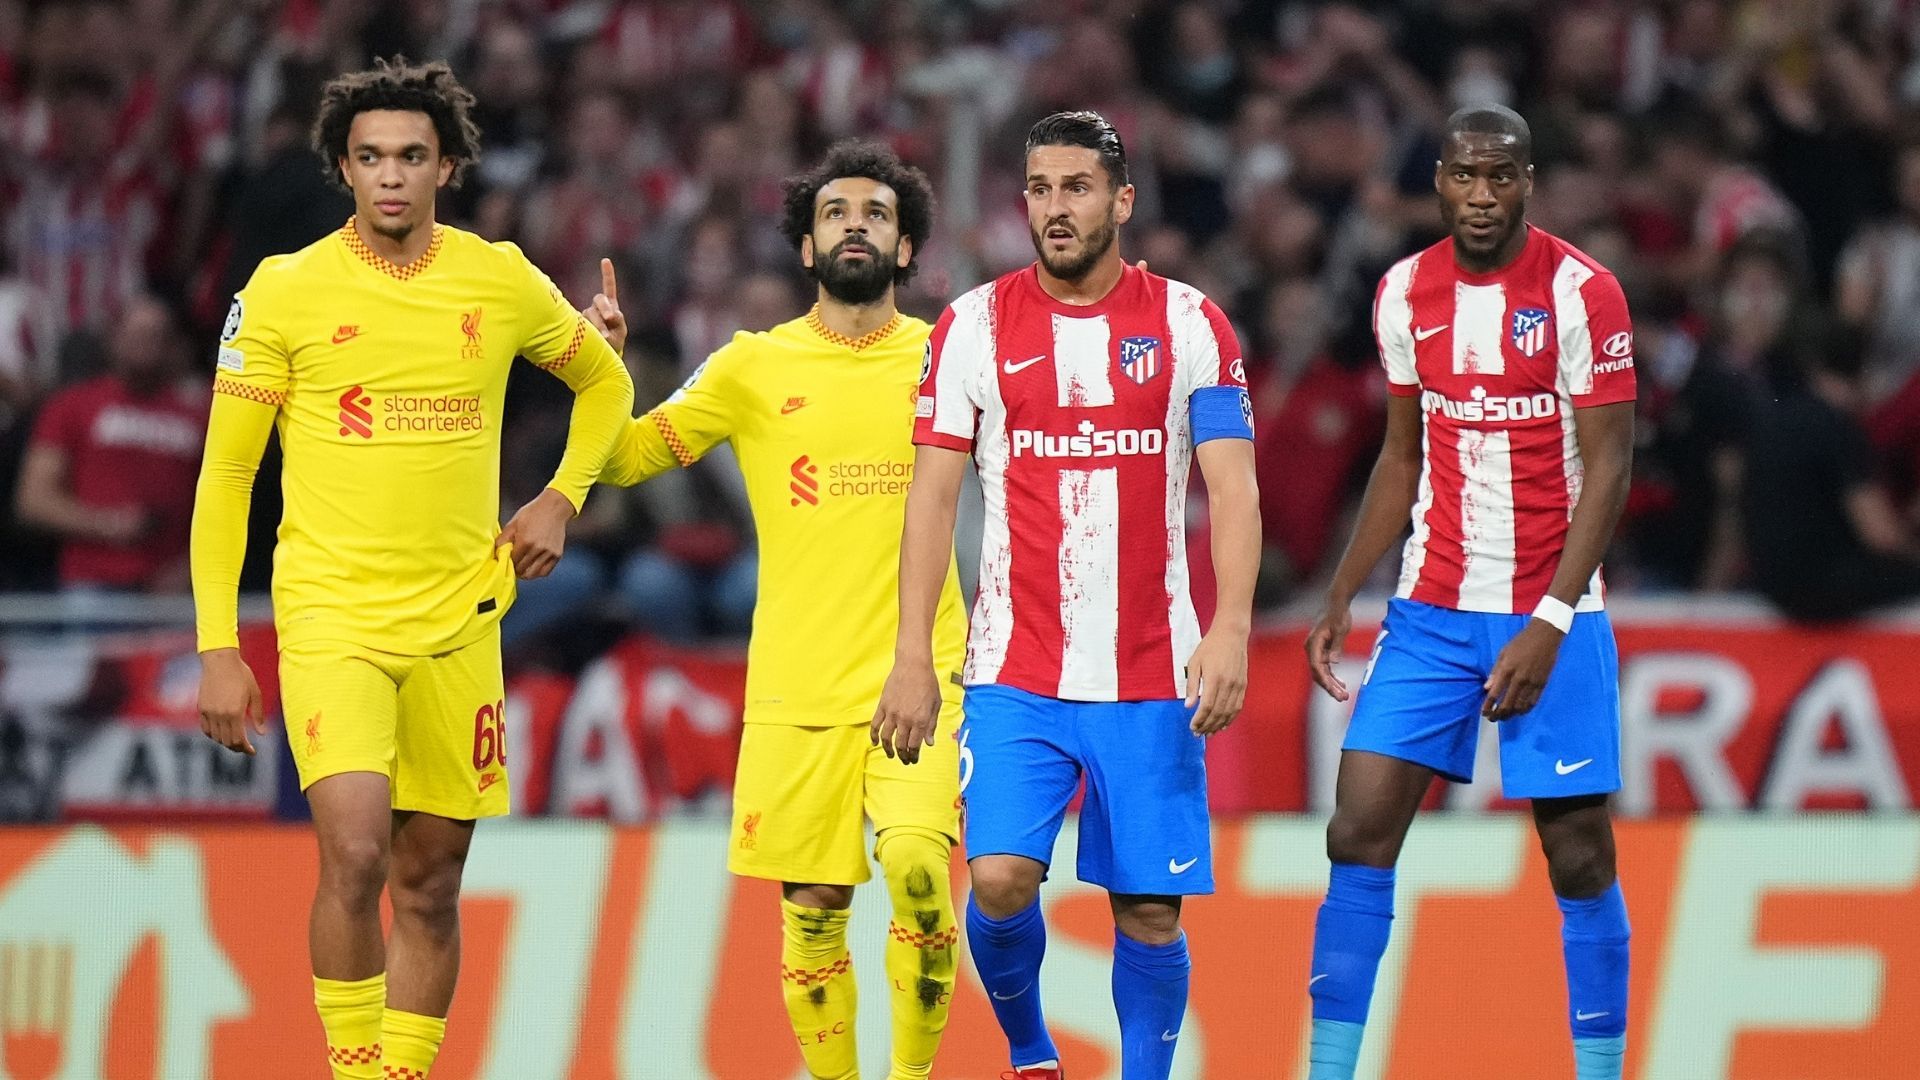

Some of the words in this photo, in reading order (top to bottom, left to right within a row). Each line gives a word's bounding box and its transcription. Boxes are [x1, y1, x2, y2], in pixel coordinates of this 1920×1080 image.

[337, 326, 359, 337] NIKE
[1593, 357, 1634, 374] HYUND
[383, 394, 481, 413] standard
[786, 396, 807, 407] NIKE
[1426, 388, 1556, 422] Plus500
[384, 413, 483, 432] chartered
[1012, 427, 1162, 458] Plus500
[829, 460, 913, 479] standar
